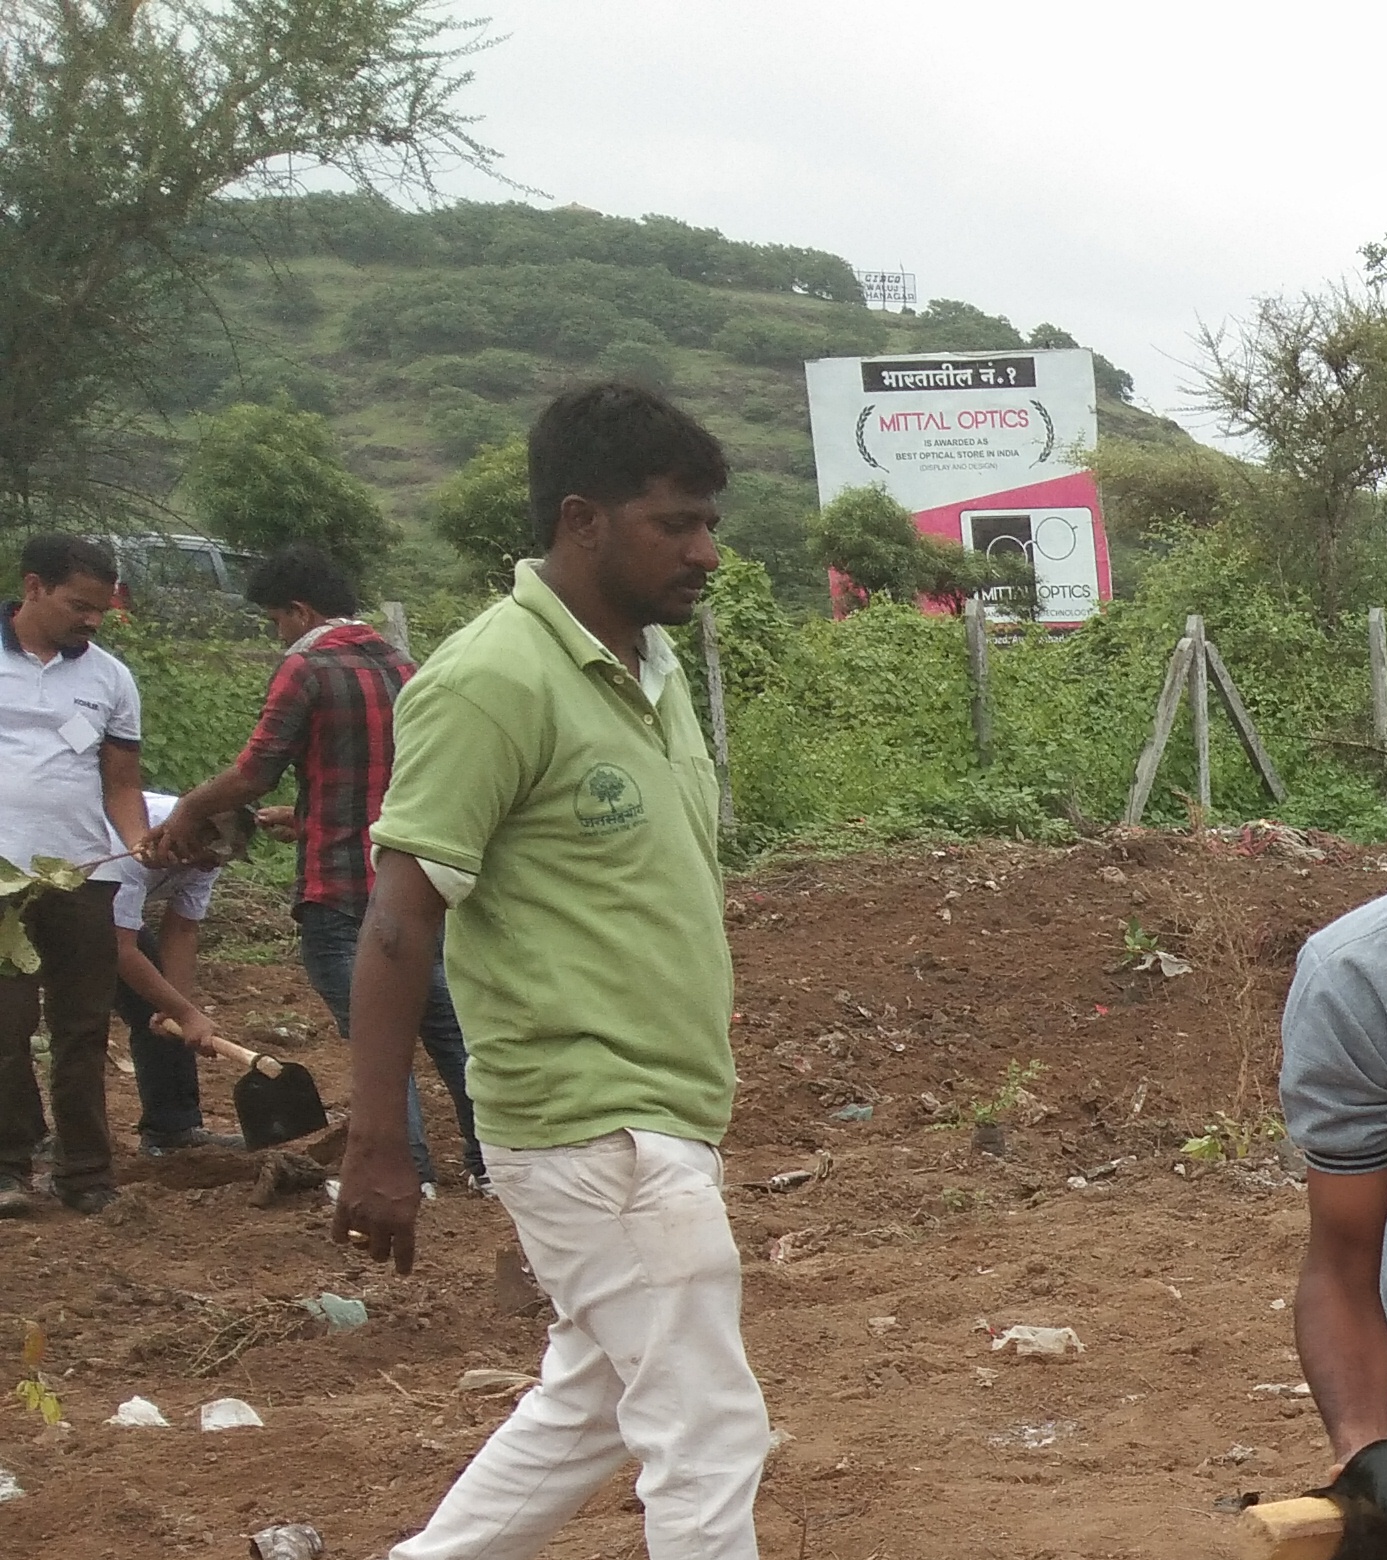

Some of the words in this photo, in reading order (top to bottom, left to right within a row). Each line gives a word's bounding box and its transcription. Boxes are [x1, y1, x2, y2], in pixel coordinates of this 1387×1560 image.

[881, 363, 973, 388] भारतातील
[879, 411, 951, 432] MITTAL
[957, 409, 1029, 429] OPTICS
[934, 438, 975, 447] AWARDED
[896, 452, 917, 460] BEST
[919, 451, 955, 460] OPTICAL
[957, 450, 984, 459] STORE
[987, 450, 995, 458] IN
[997, 449, 1019, 457] INDIA
[982, 585, 1029, 601] MITTA
[1039, 584, 1091, 599] OPTICS
